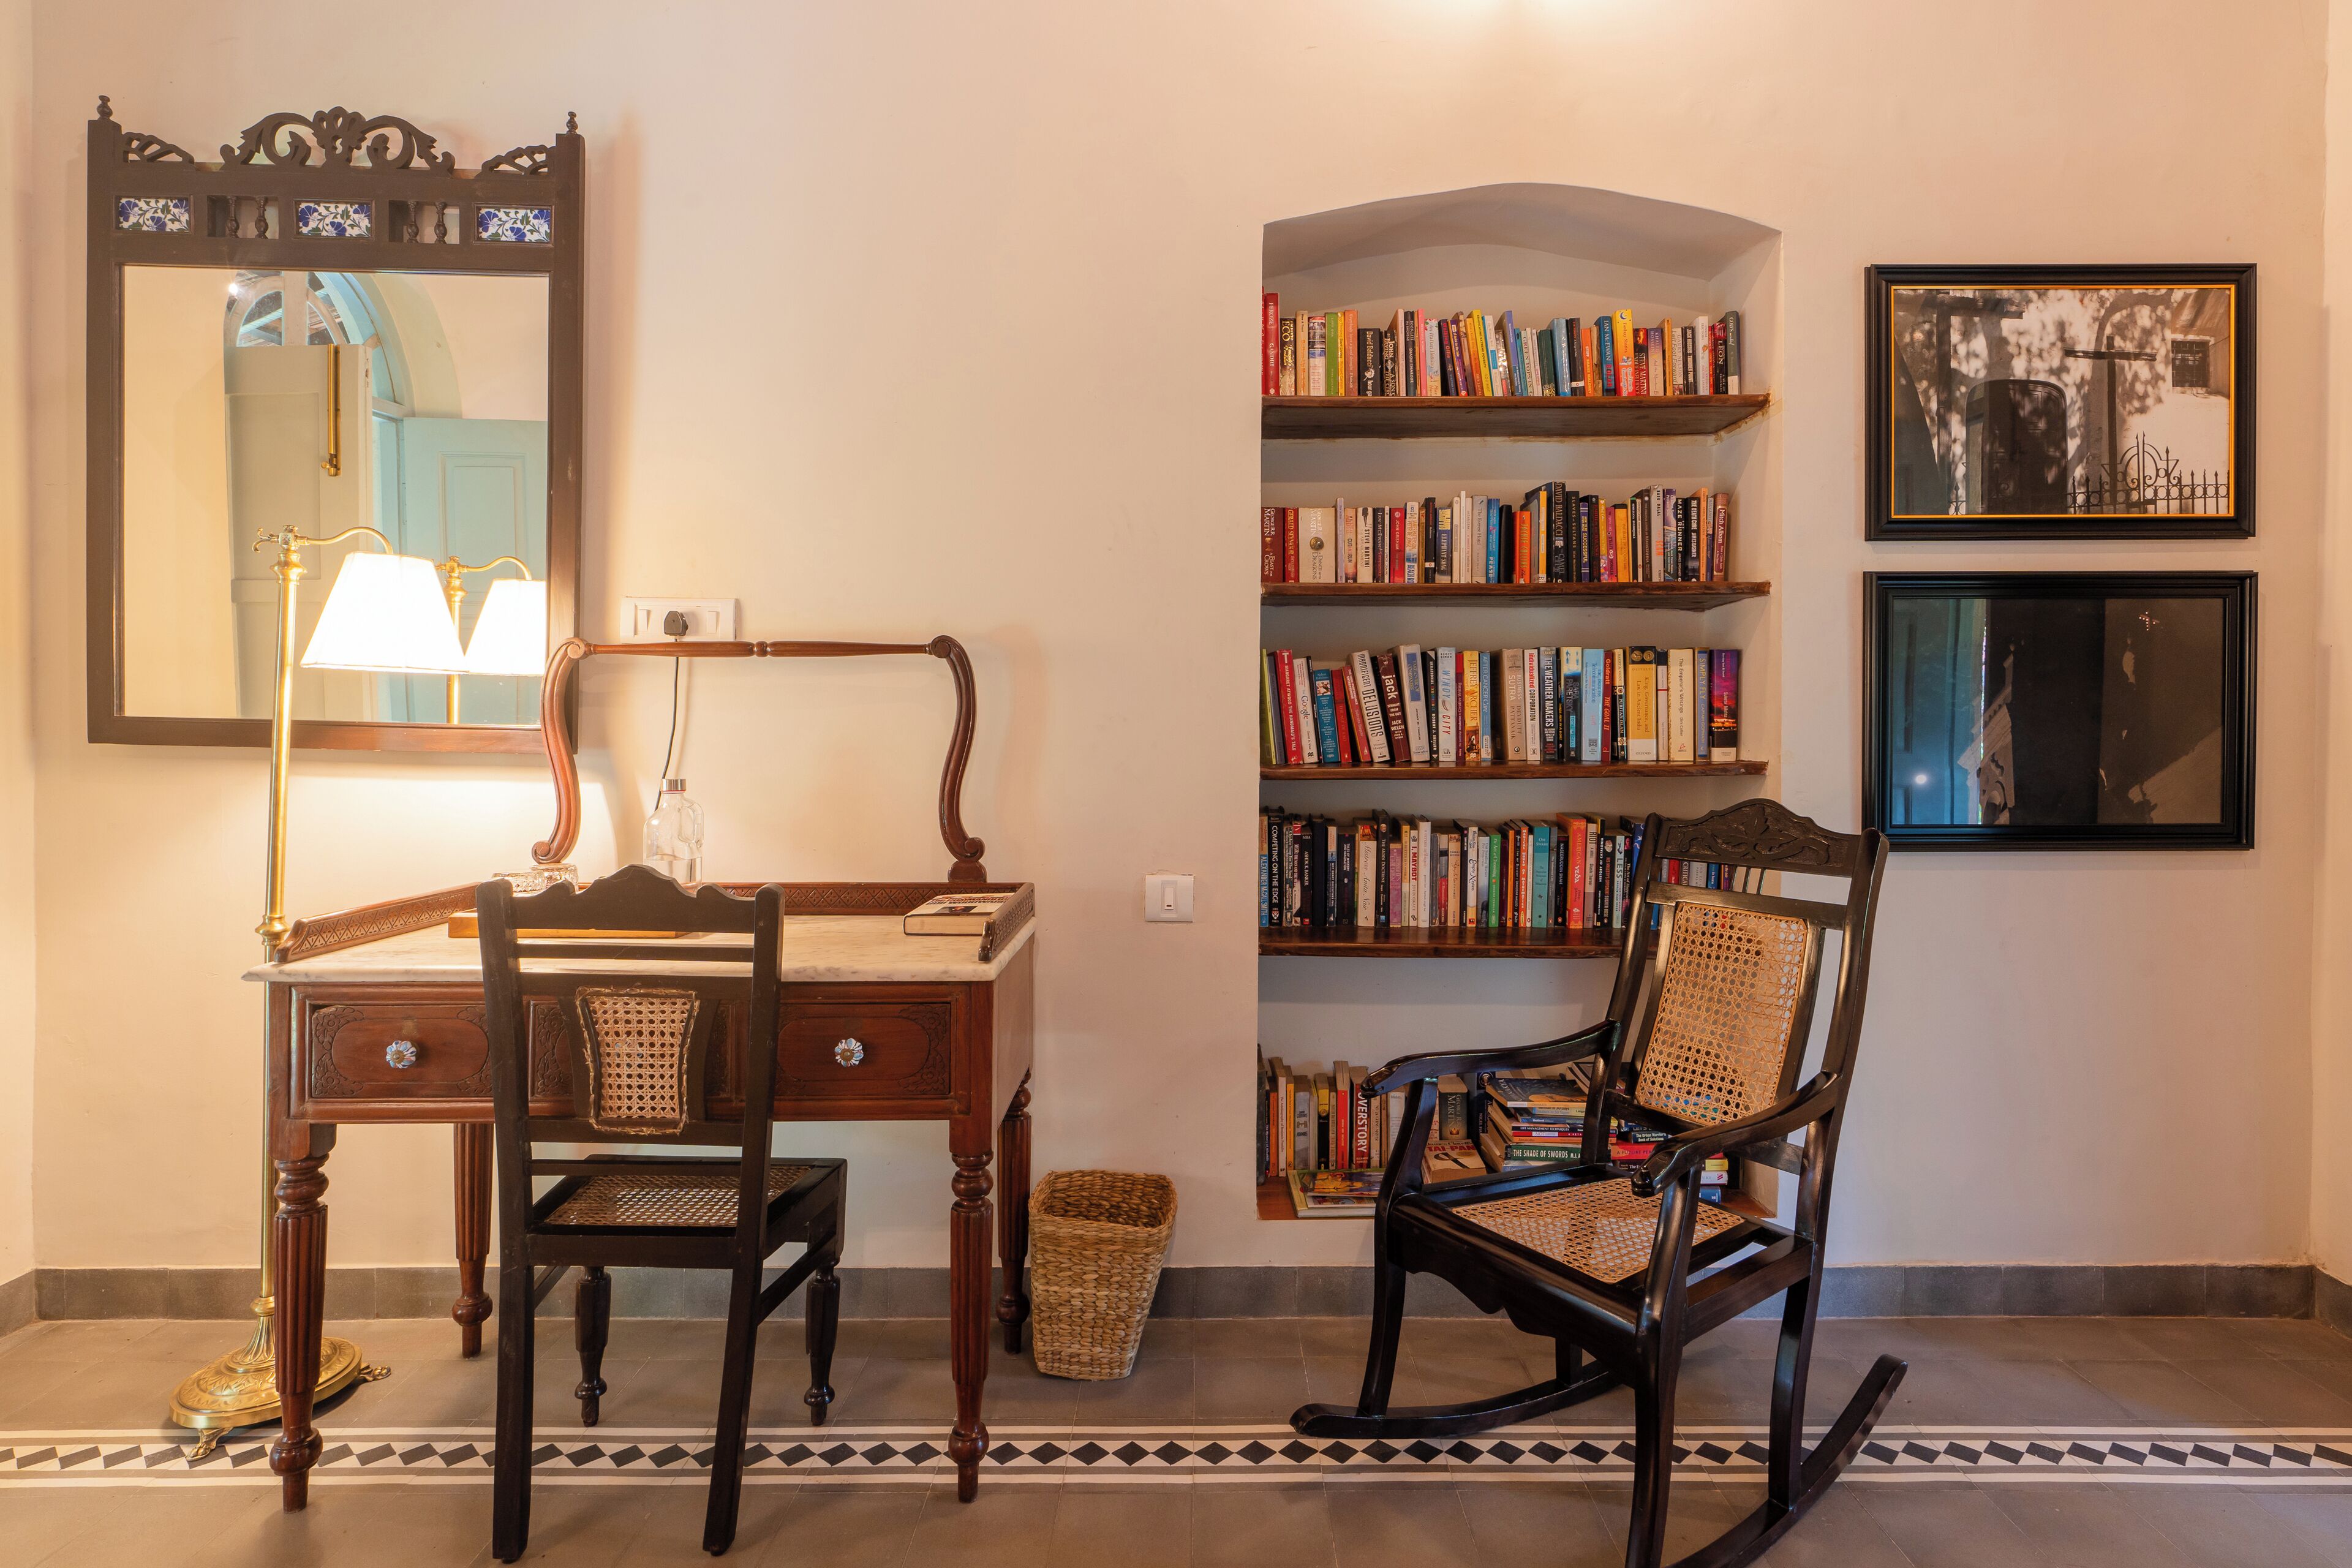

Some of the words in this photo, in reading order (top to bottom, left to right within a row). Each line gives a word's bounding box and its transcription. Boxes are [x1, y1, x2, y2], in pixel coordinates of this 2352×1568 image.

[1357, 654, 1371, 687] MAGNIFICENT
[1468, 660, 1478, 687] JEFFREY
[1544, 657, 1552, 669] THE
[1382, 674, 1398, 699] jack
[1300, 696, 1310, 720] Google
[1362, 689, 1384, 737] DELUSIONS
[1545, 700, 1554, 726] MAKERS
